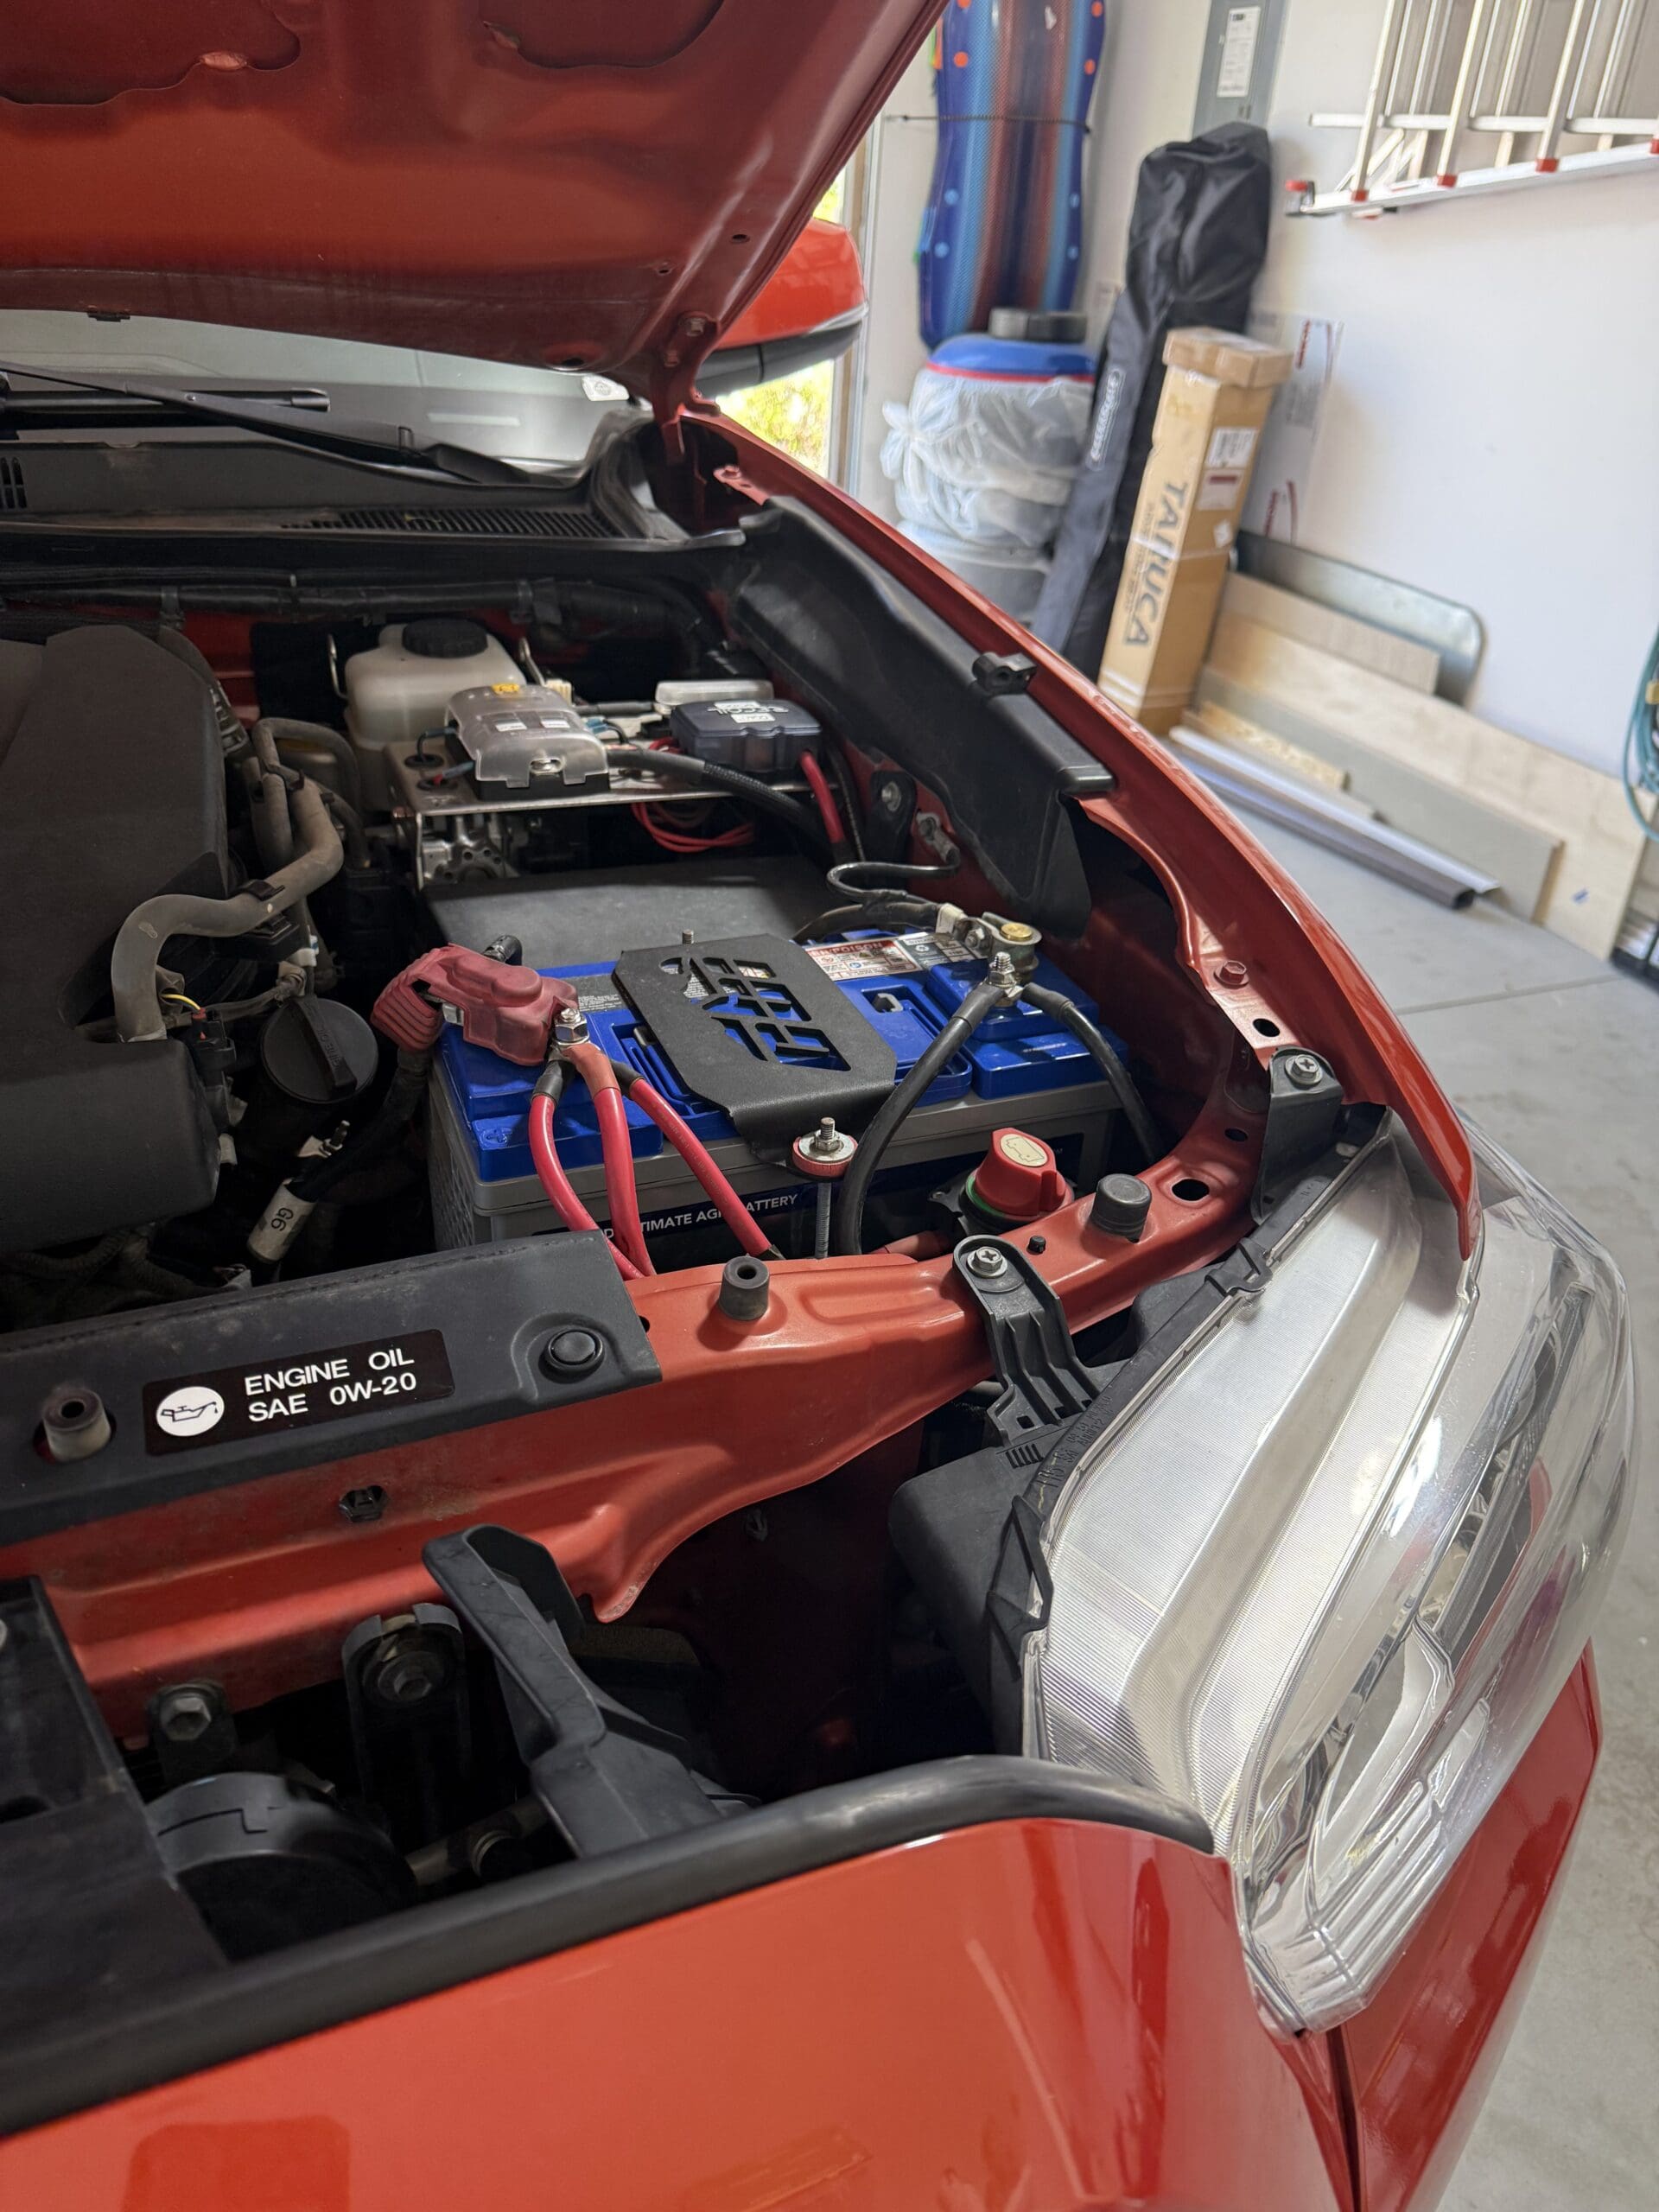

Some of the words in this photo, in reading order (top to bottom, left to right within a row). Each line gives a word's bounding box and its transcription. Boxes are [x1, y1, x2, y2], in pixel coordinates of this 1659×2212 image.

[270, 1207, 294, 1231] G6
[640, 1213, 692, 1232] TIMATE
[696, 1208, 721, 1223] AG
[746, 1194, 798, 1211] ATTERY
[244, 1358, 350, 1396] ENGINE
[368, 1348, 415, 1370] OIL
[248, 1393, 308, 1422] SAE
[329, 1372, 416, 1407] 0W-20
